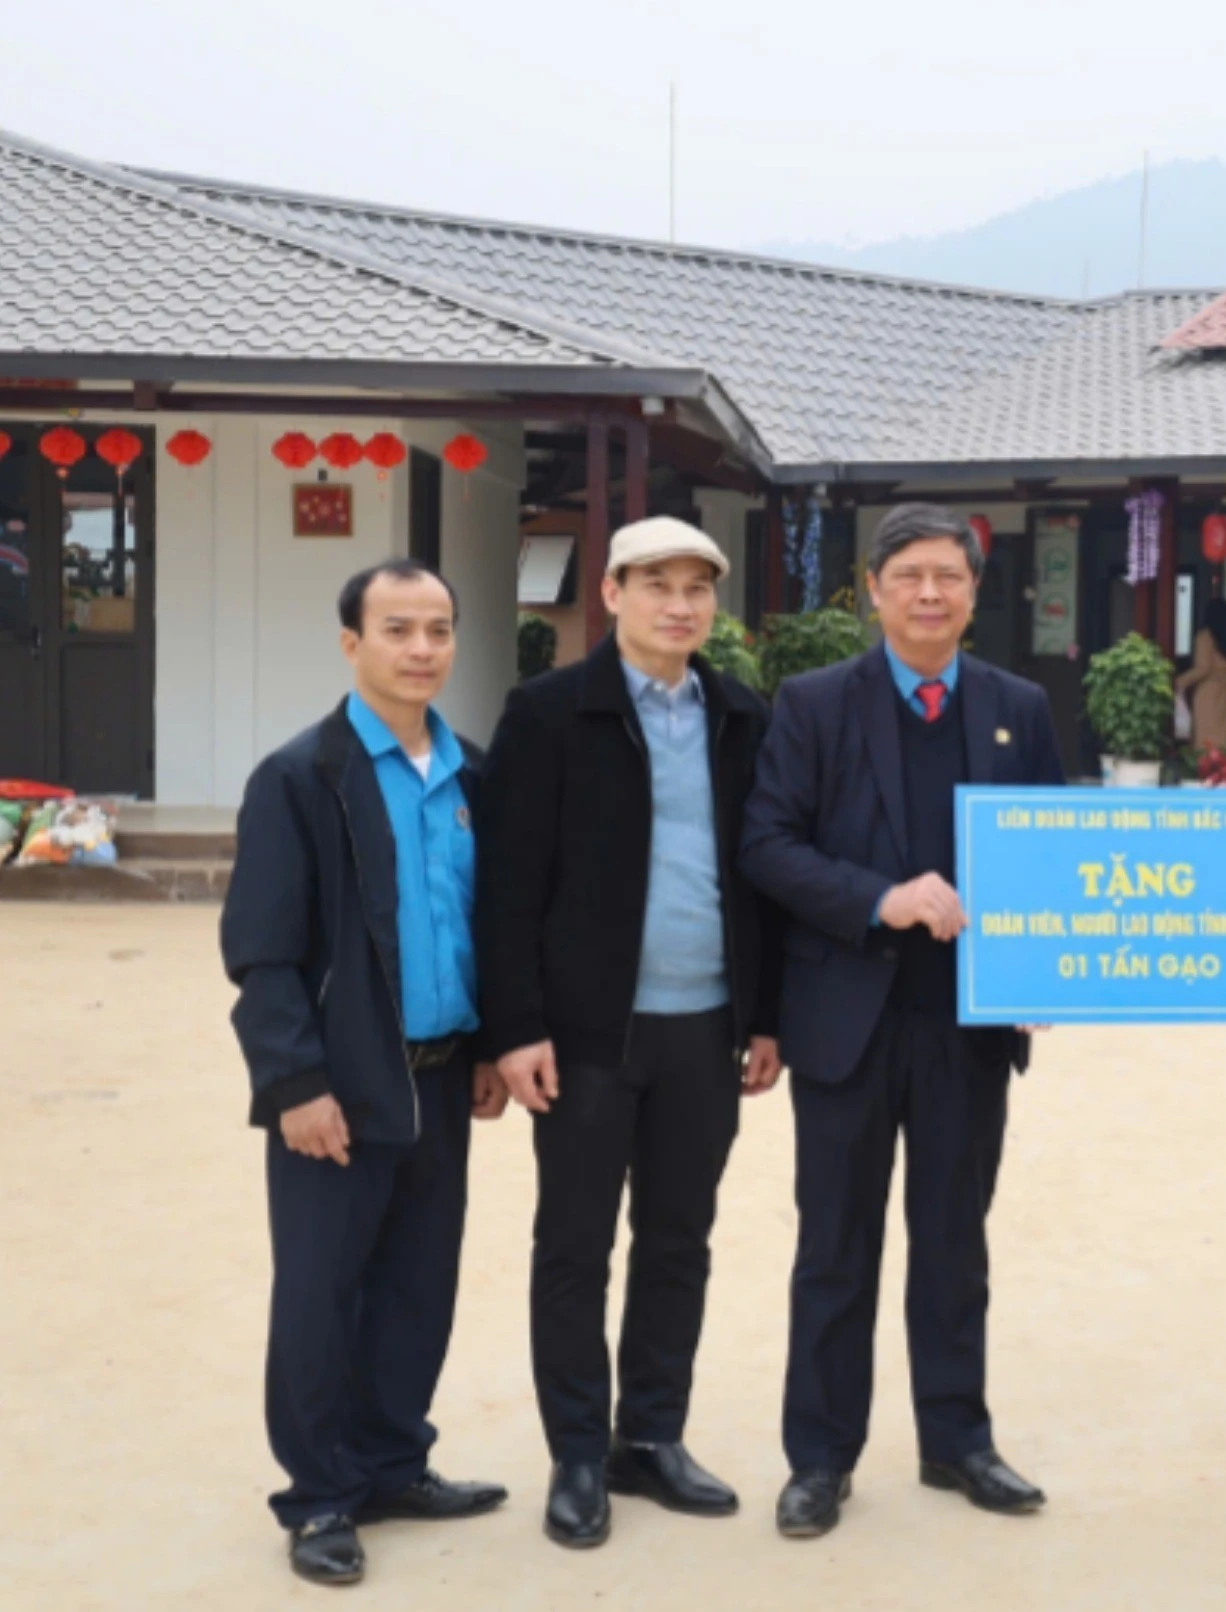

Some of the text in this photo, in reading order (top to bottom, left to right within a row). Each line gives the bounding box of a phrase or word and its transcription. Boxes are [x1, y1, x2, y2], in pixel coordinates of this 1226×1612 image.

[1078, 852, 1195, 907] TẶNG
[1059, 944, 1220, 985] 01 TẤN GẠO
